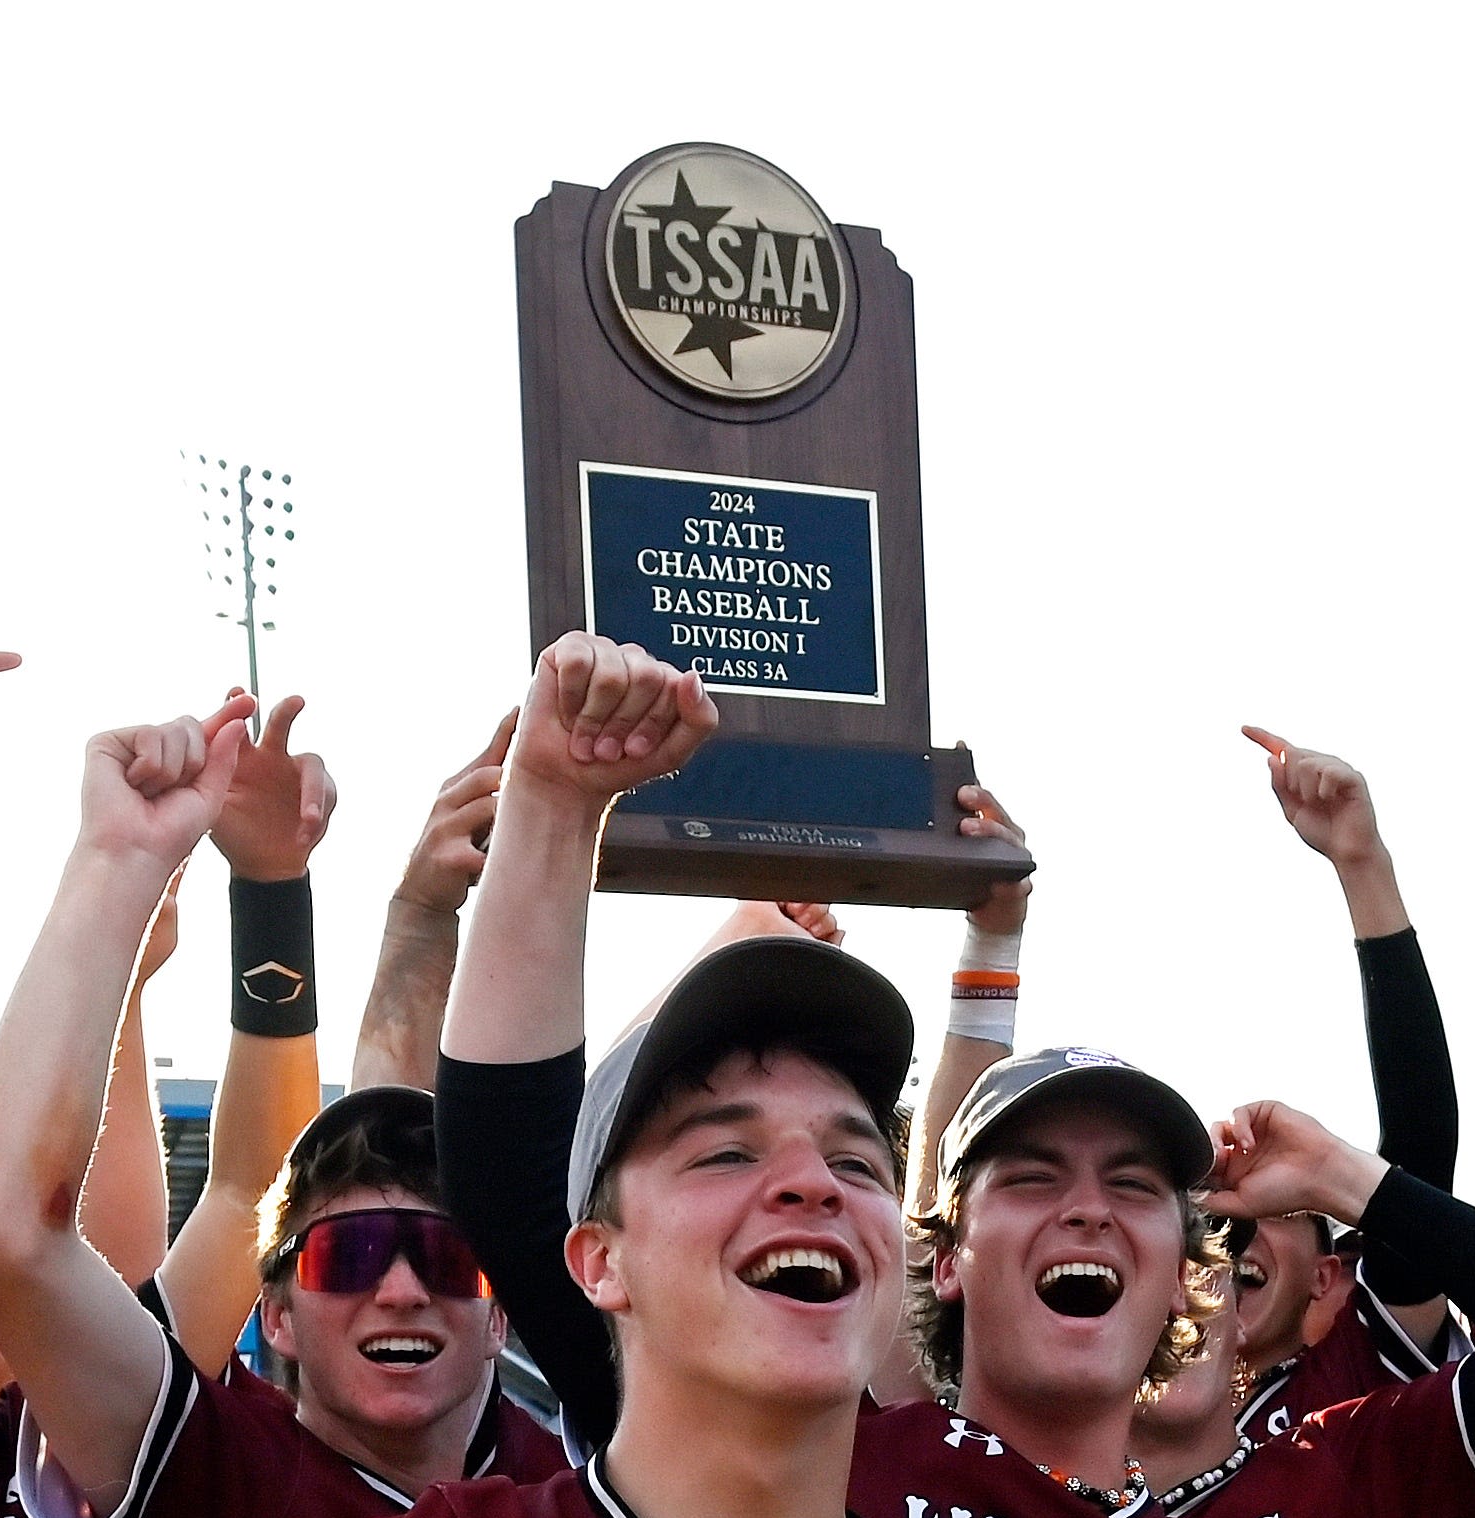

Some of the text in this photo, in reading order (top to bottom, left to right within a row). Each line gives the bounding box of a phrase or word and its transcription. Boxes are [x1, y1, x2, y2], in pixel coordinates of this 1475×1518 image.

[623, 216, 830, 311] TSSAA
[658, 294, 803, 326] CHAMPIONSHIPS
[709, 490, 756, 514] 2024
[683, 517, 786, 553] STATE
[636, 549, 832, 592] CHAMPIONS
[652, 586, 821, 625] BASEBALL
[671, 622, 807, 655] DIVISION I
[691, 656, 789, 681] CLASS 3A
